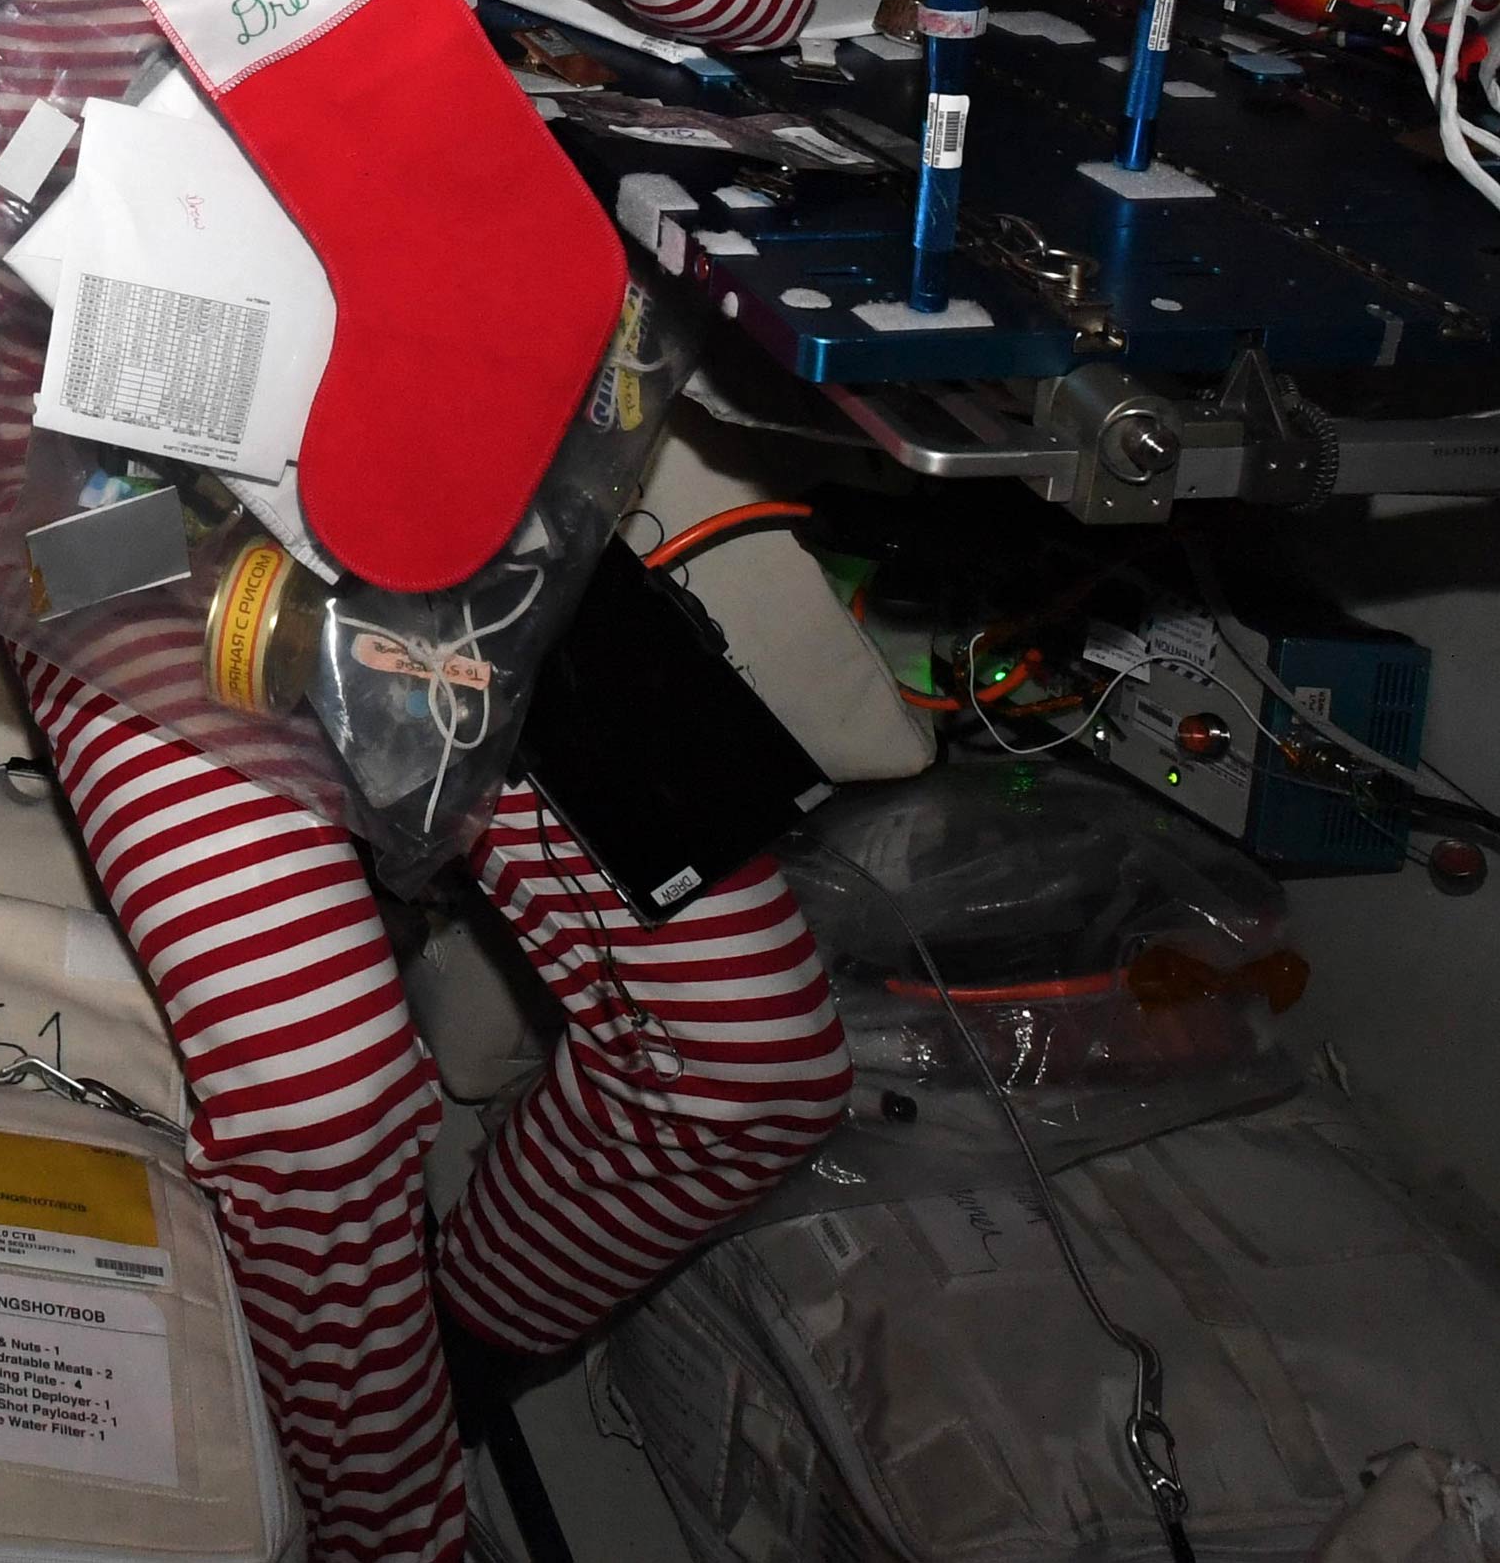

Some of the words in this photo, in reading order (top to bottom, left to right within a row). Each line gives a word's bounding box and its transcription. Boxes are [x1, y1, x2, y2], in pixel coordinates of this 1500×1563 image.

[227, 633, 247, 700] РЯНАЯ
[238, 554, 272, 616] РИСОМ
[661, 874, 693, 902] DREW
[12, 1231, 36, 1242] CTB
[11, 1338, 41, 1353] Nuts
[54, 1360, 93, 1376] Meats
[24, 1371, 57, 1386] Plate
[32, 1388, 91, 1408] Deployer
[32, 1403, 98, 1424] Payload-2
[9, 1415, 48, 1432] Water
[51, 1422, 86, 1438] Filter
